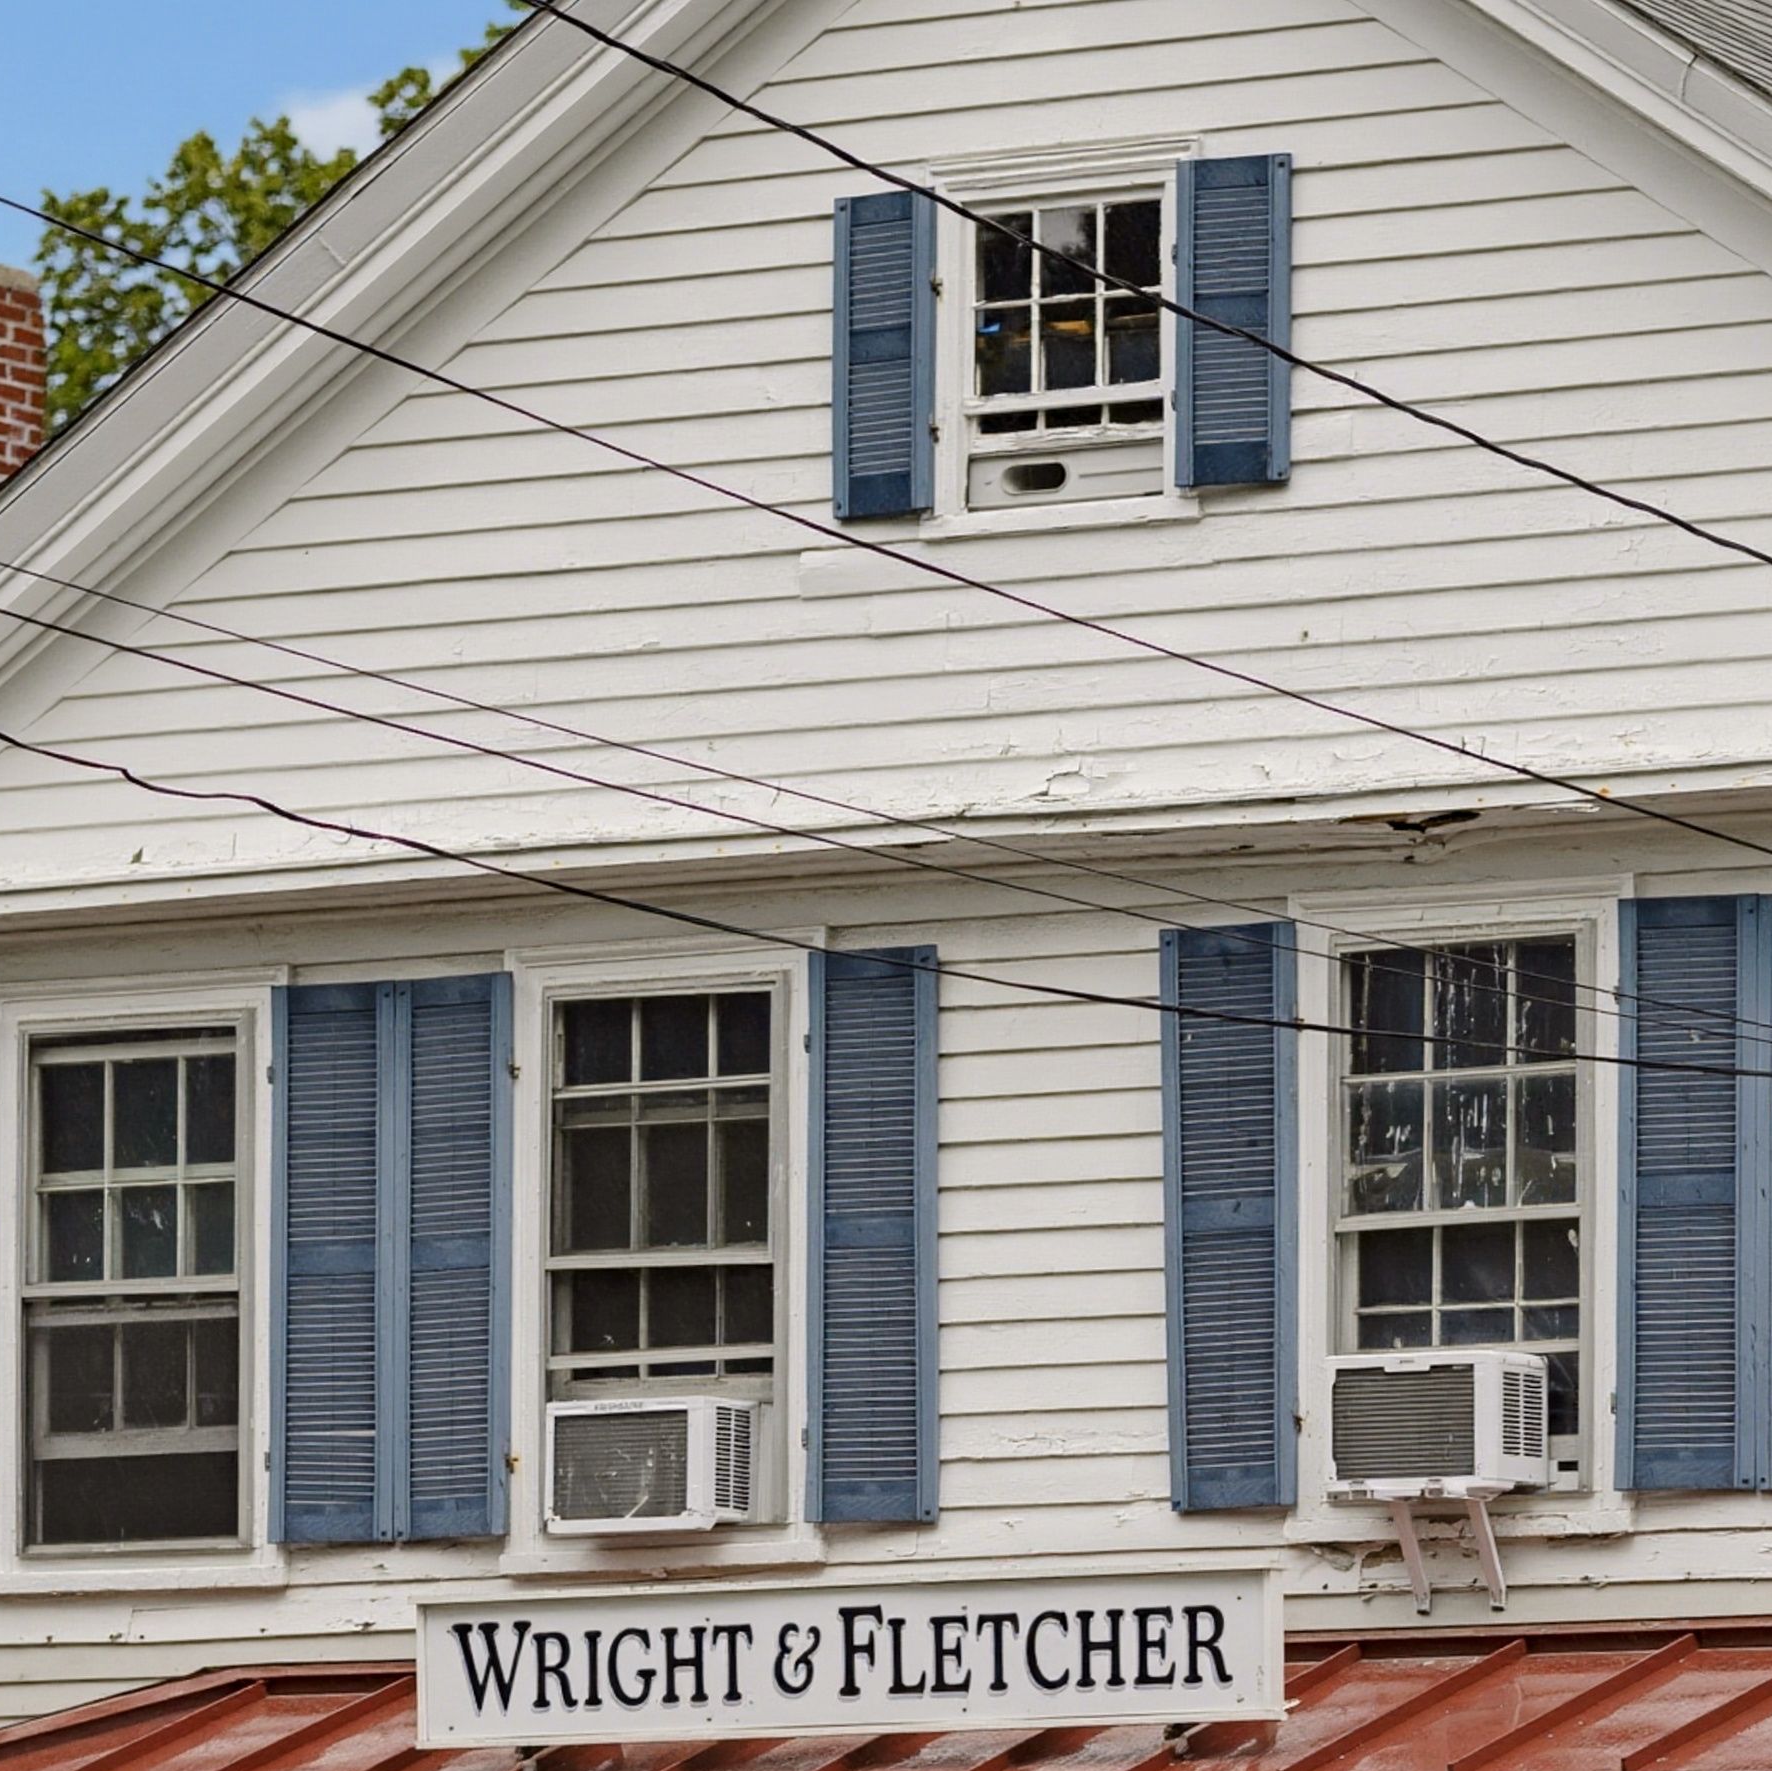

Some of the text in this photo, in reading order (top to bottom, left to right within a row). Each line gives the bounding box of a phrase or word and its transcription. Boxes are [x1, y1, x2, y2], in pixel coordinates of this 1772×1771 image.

[452, 1603, 1233, 1714] WRIGHT & FLETCHER
